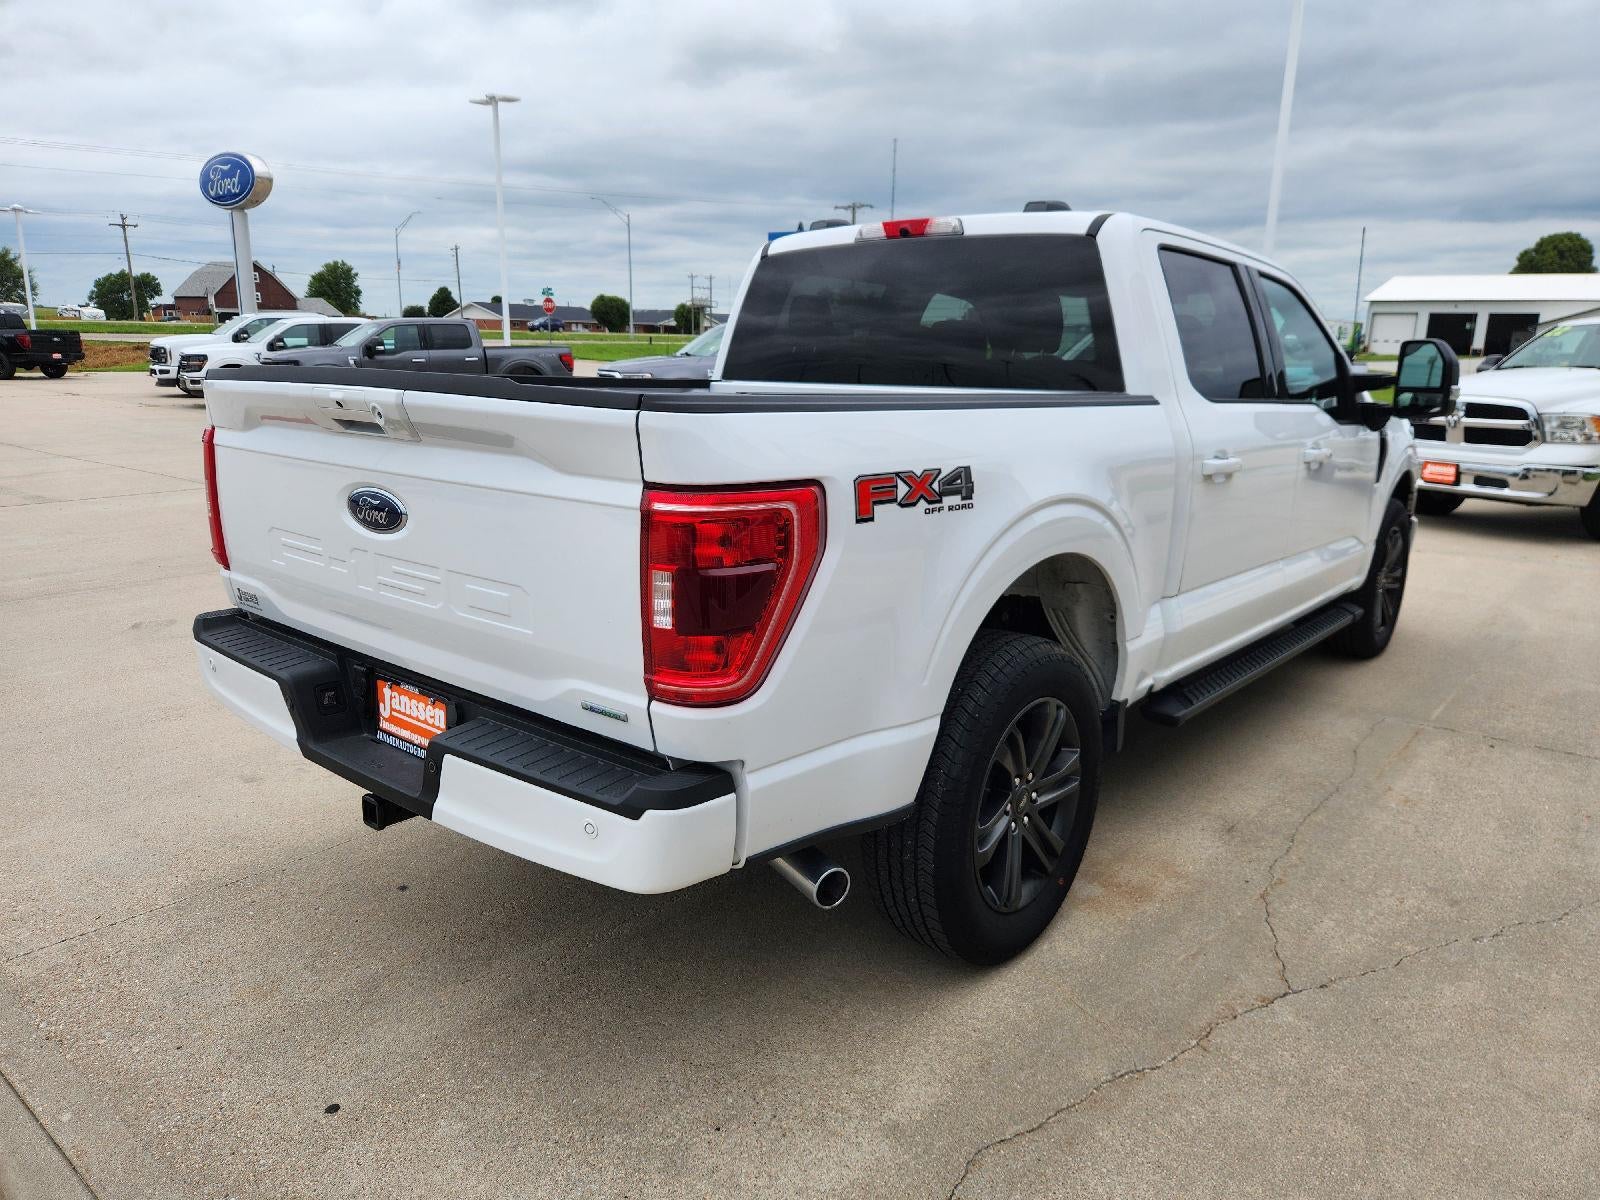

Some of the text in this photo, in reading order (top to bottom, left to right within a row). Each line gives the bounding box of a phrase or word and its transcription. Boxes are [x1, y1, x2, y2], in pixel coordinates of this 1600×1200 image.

[208, 164, 241, 197] Ford
[356, 496, 389, 524] Ford
[854, 465, 974, 524] FX4
[924, 502, 975, 515] OFF ROAD
[268, 526, 534, 634] F-150
[379, 687, 446, 729] Janssen
